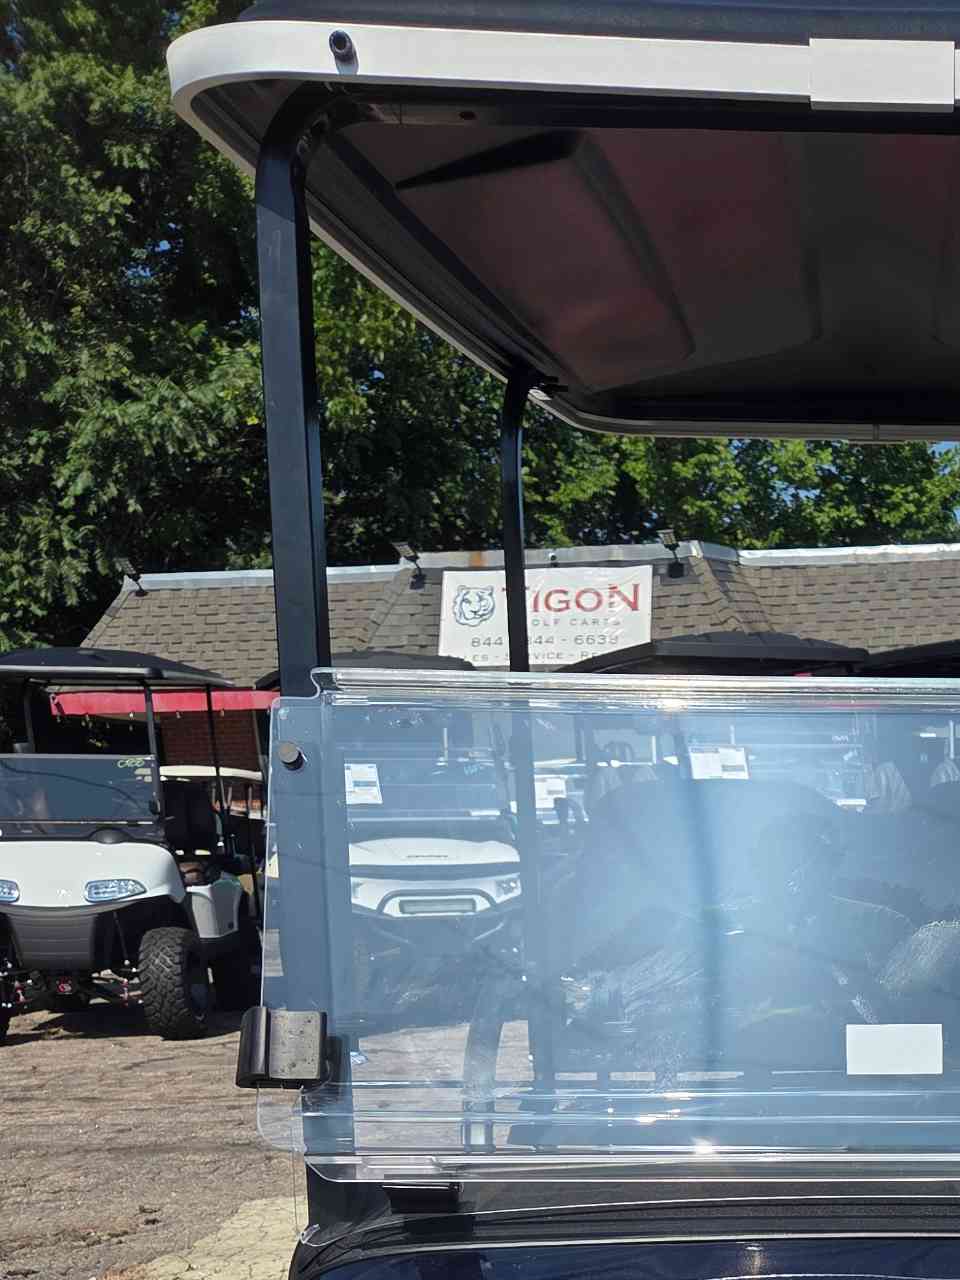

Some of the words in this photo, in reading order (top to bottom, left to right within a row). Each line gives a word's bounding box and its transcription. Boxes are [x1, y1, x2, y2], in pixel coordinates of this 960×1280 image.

[502, 583, 640, 613] IGON
[531, 618, 561, 626] OLF
[471, 636, 504, 648] 844
